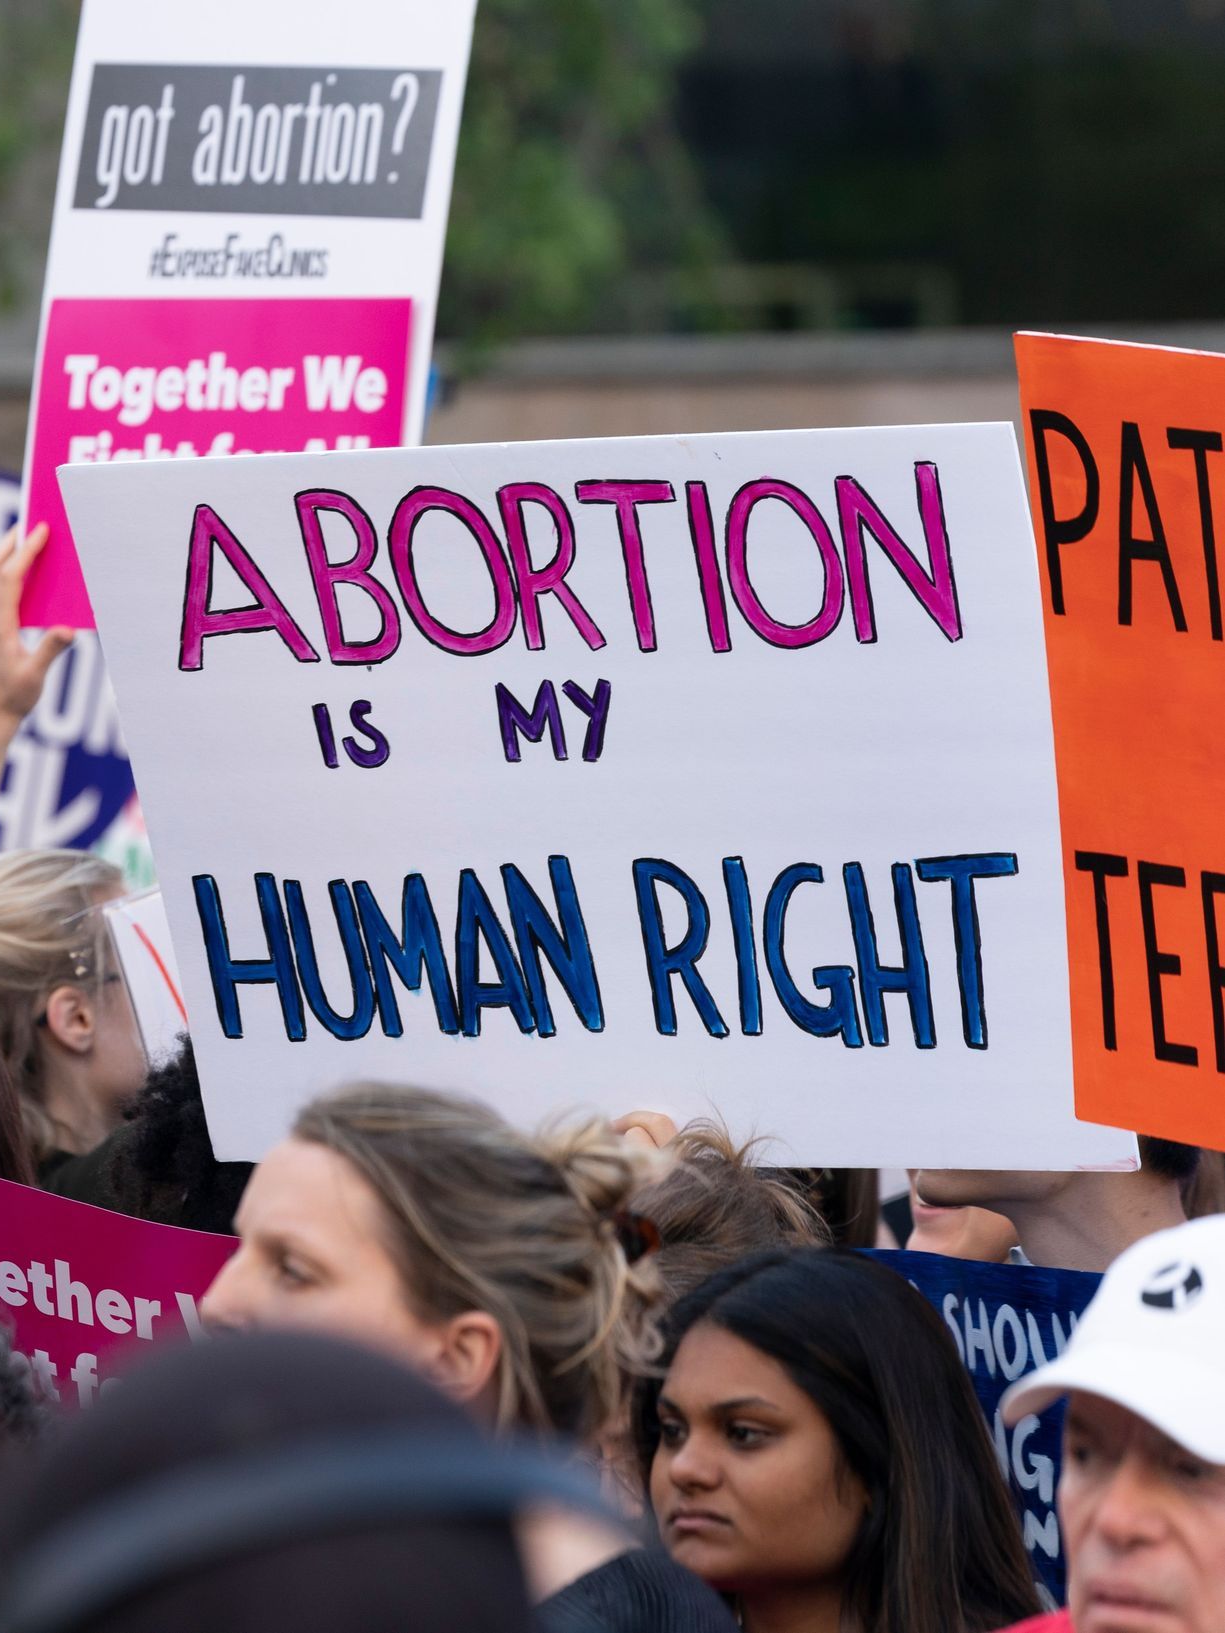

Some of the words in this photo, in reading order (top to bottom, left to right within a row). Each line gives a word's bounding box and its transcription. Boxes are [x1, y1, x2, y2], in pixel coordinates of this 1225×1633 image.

[95, 83, 175, 208] got
[192, 73, 419, 187] abortion?
[65, 351, 294, 426] Together
[303, 355, 388, 414] We
[178, 460, 965, 671] ABORTION
[312, 699, 391, 769] IS
[496, 678, 612, 763] MY
[192, 854, 607, 1043] HUMAN
[632, 852, 1019, 1051] RIGHT
